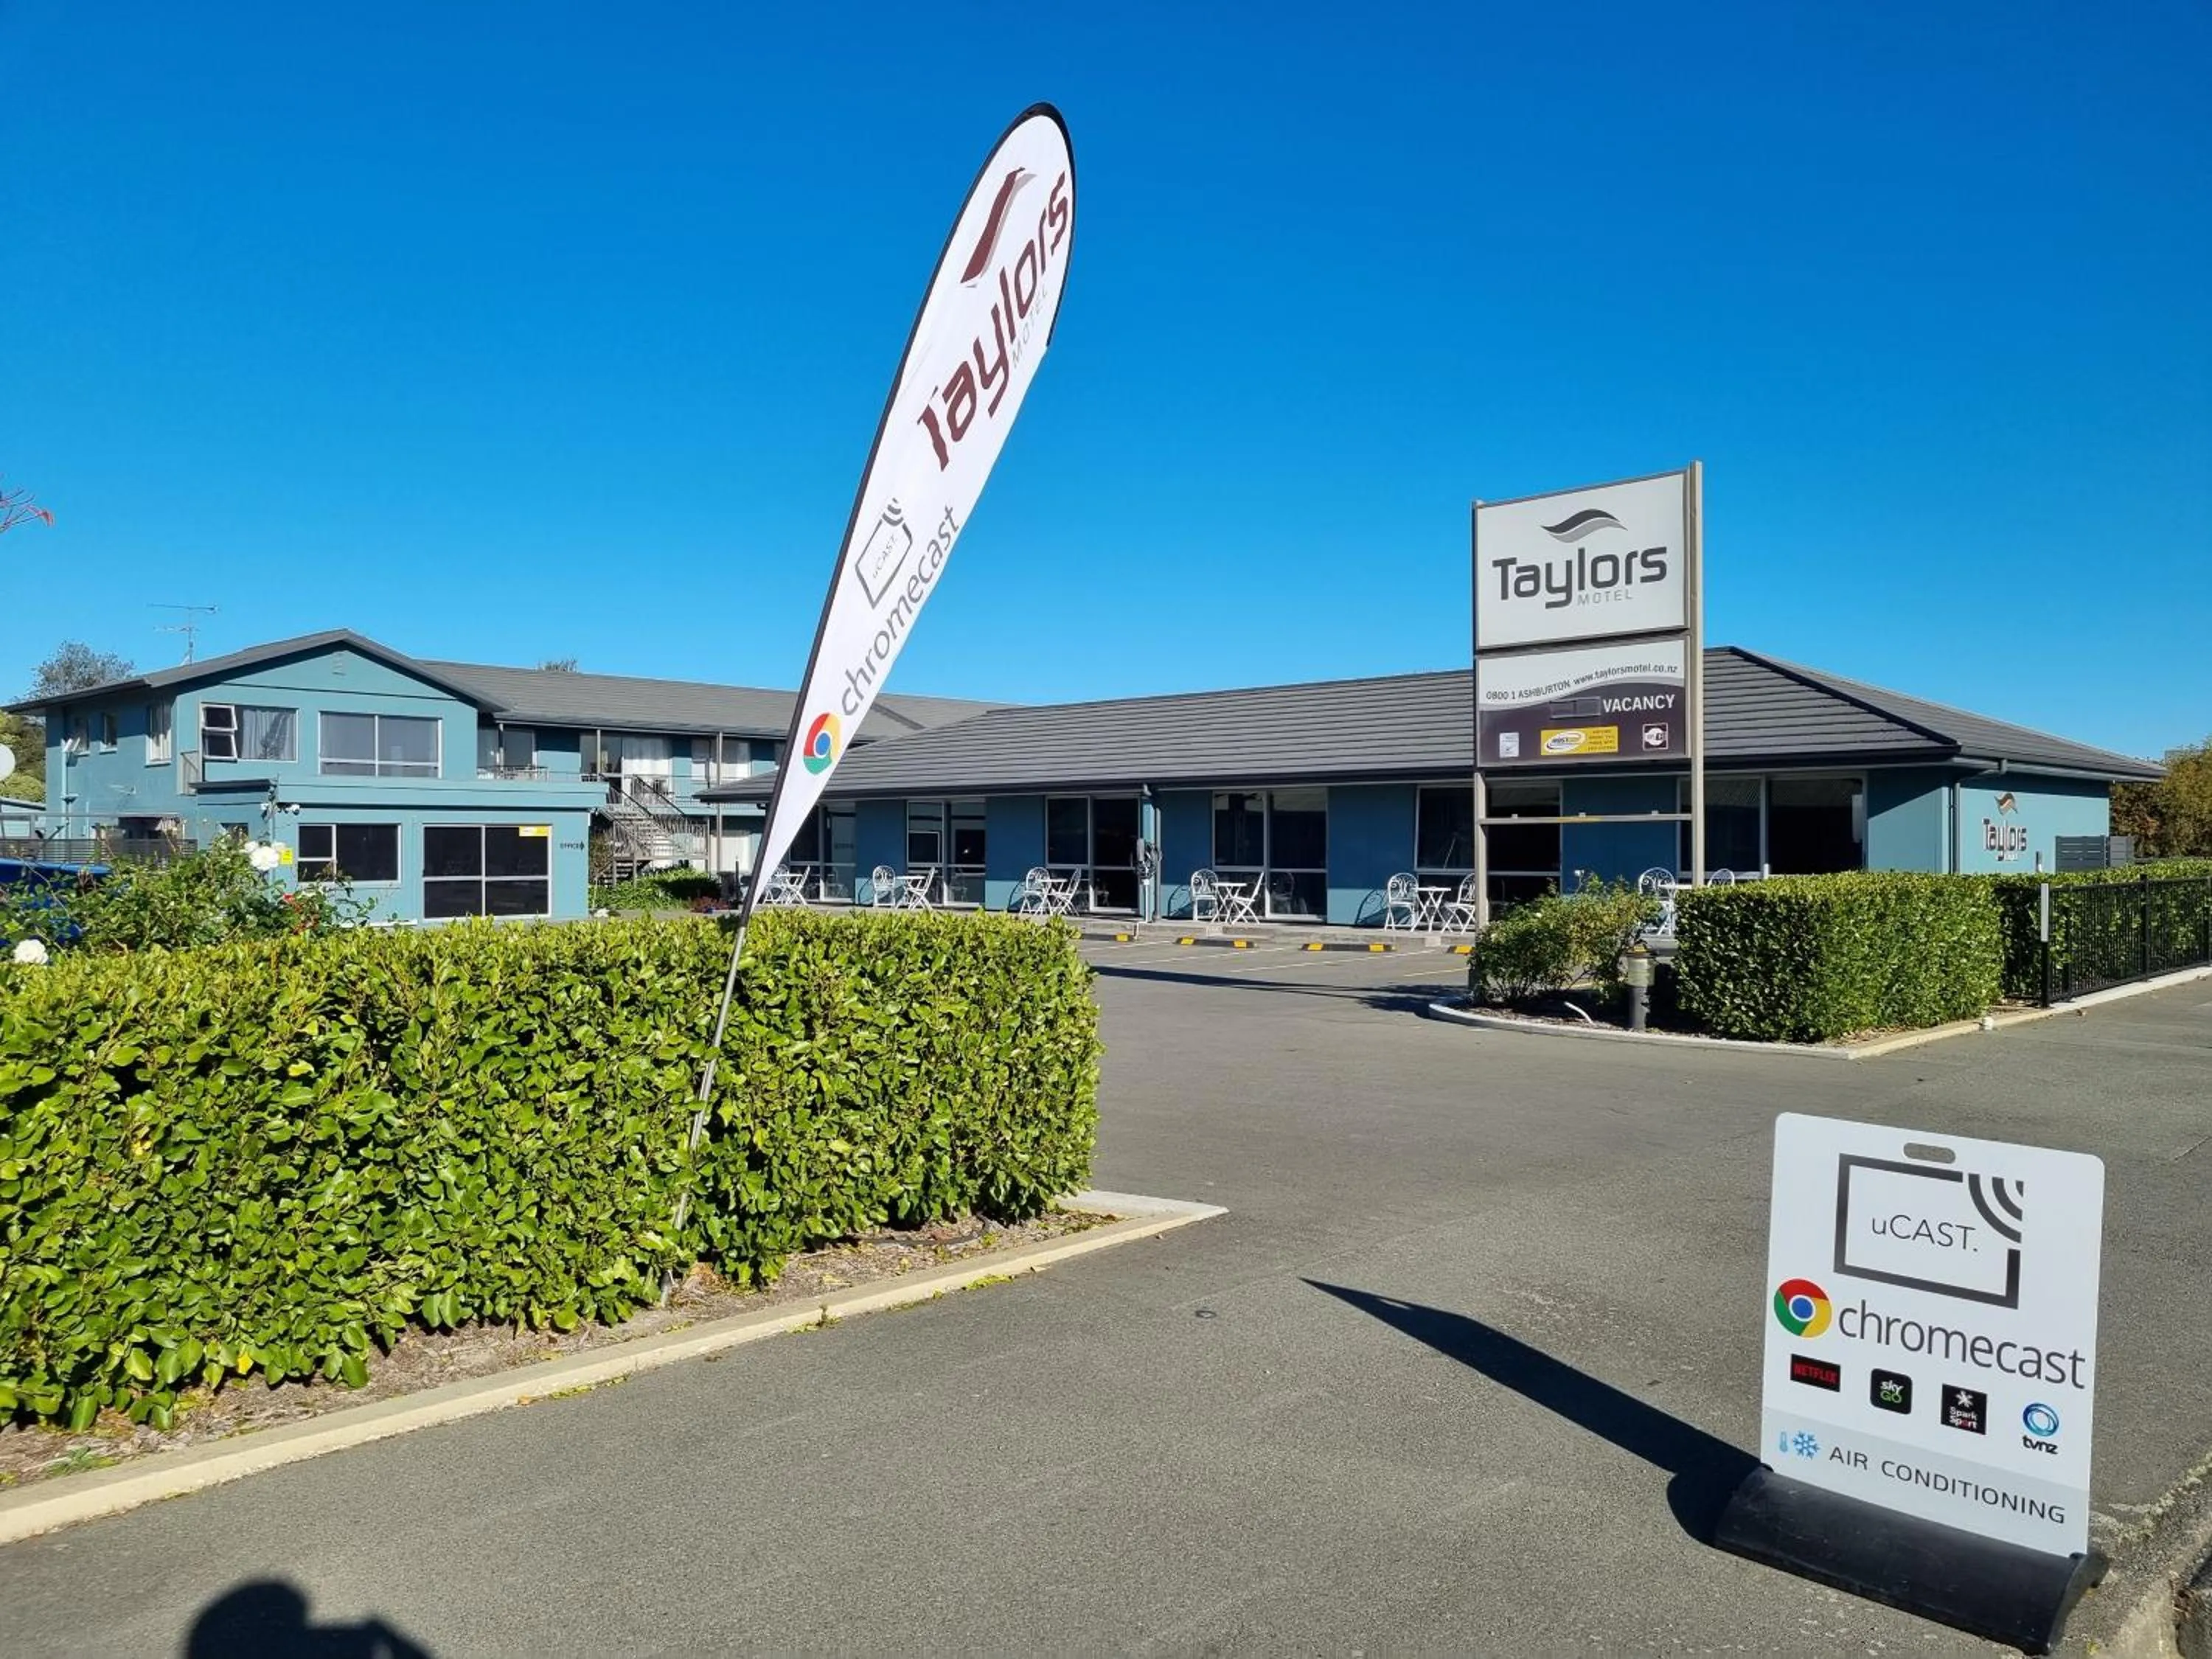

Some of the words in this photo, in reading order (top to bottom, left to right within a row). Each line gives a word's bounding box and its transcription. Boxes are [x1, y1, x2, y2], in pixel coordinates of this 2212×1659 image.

[917, 170, 1068, 472] Taylors
[1492, 546, 1667, 609] Taylors
[841, 505, 960, 716] chromecast
[1577, 590, 1633, 606] MOTEL
[1486, 691, 1509, 700] 0800
[1512, 692, 1515, 700] 1
[1518, 679, 1571, 698] ASHBURTON
[1573, 664, 1677, 685] www.taylorsmotel.co.nz
[1602, 694, 1675, 713] VACANCY
[1982, 818, 2027, 861] Taylors
[1871, 1214, 1978, 1253] uCAST.
[1838, 1299, 2086, 1390] chromecast
[1793, 1363, 1838, 1384] NETFLIX
[1881, 1380, 1904, 1395] sky
[1880, 1391, 1902, 1403] GO
[1950, 1406, 1977, 1420] Spark
[1950, 1415, 1977, 1430] Sport
[2022, 1435, 2059, 1455] tvnz
[1829, 1445, 1868, 1470] AIR
[1881, 1459, 2066, 1525] CONDITIONING
